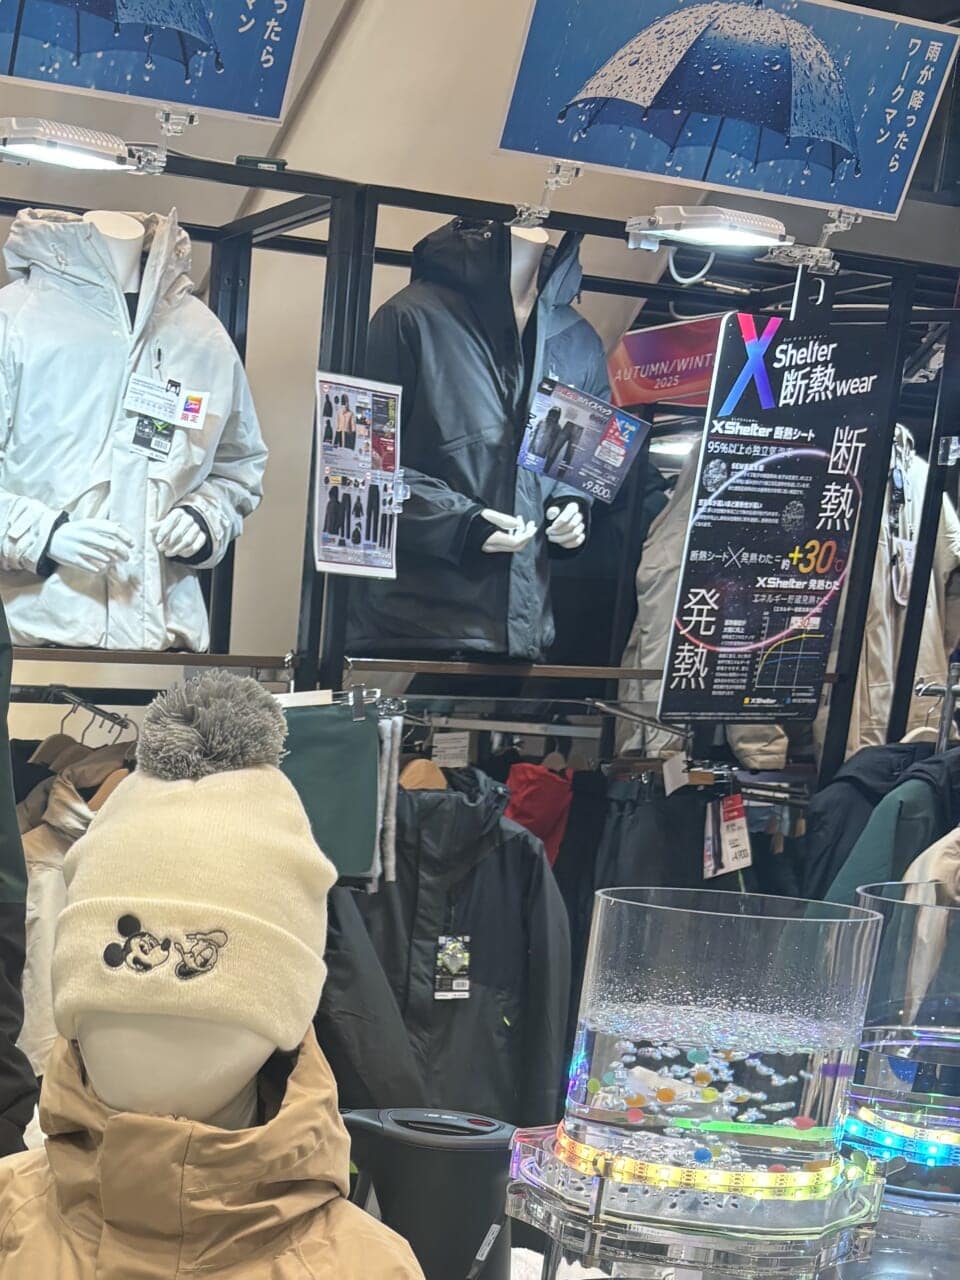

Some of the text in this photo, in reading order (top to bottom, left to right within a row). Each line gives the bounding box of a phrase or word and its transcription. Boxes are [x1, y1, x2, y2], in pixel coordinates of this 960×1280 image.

[876, 38, 923, 144] ワークマン
[888, 40, 944, 172] 雨が降ったら
[615, 353, 715, 381] AUTUMN/WINT
[653, 375, 680, 389] 2025
[773, 340, 838, 369] Shelter
[773, 426, 816, 442] 断熱シート
[816, 426, 868, 531] 断熱
[670, 588, 721, 690] 発熱
